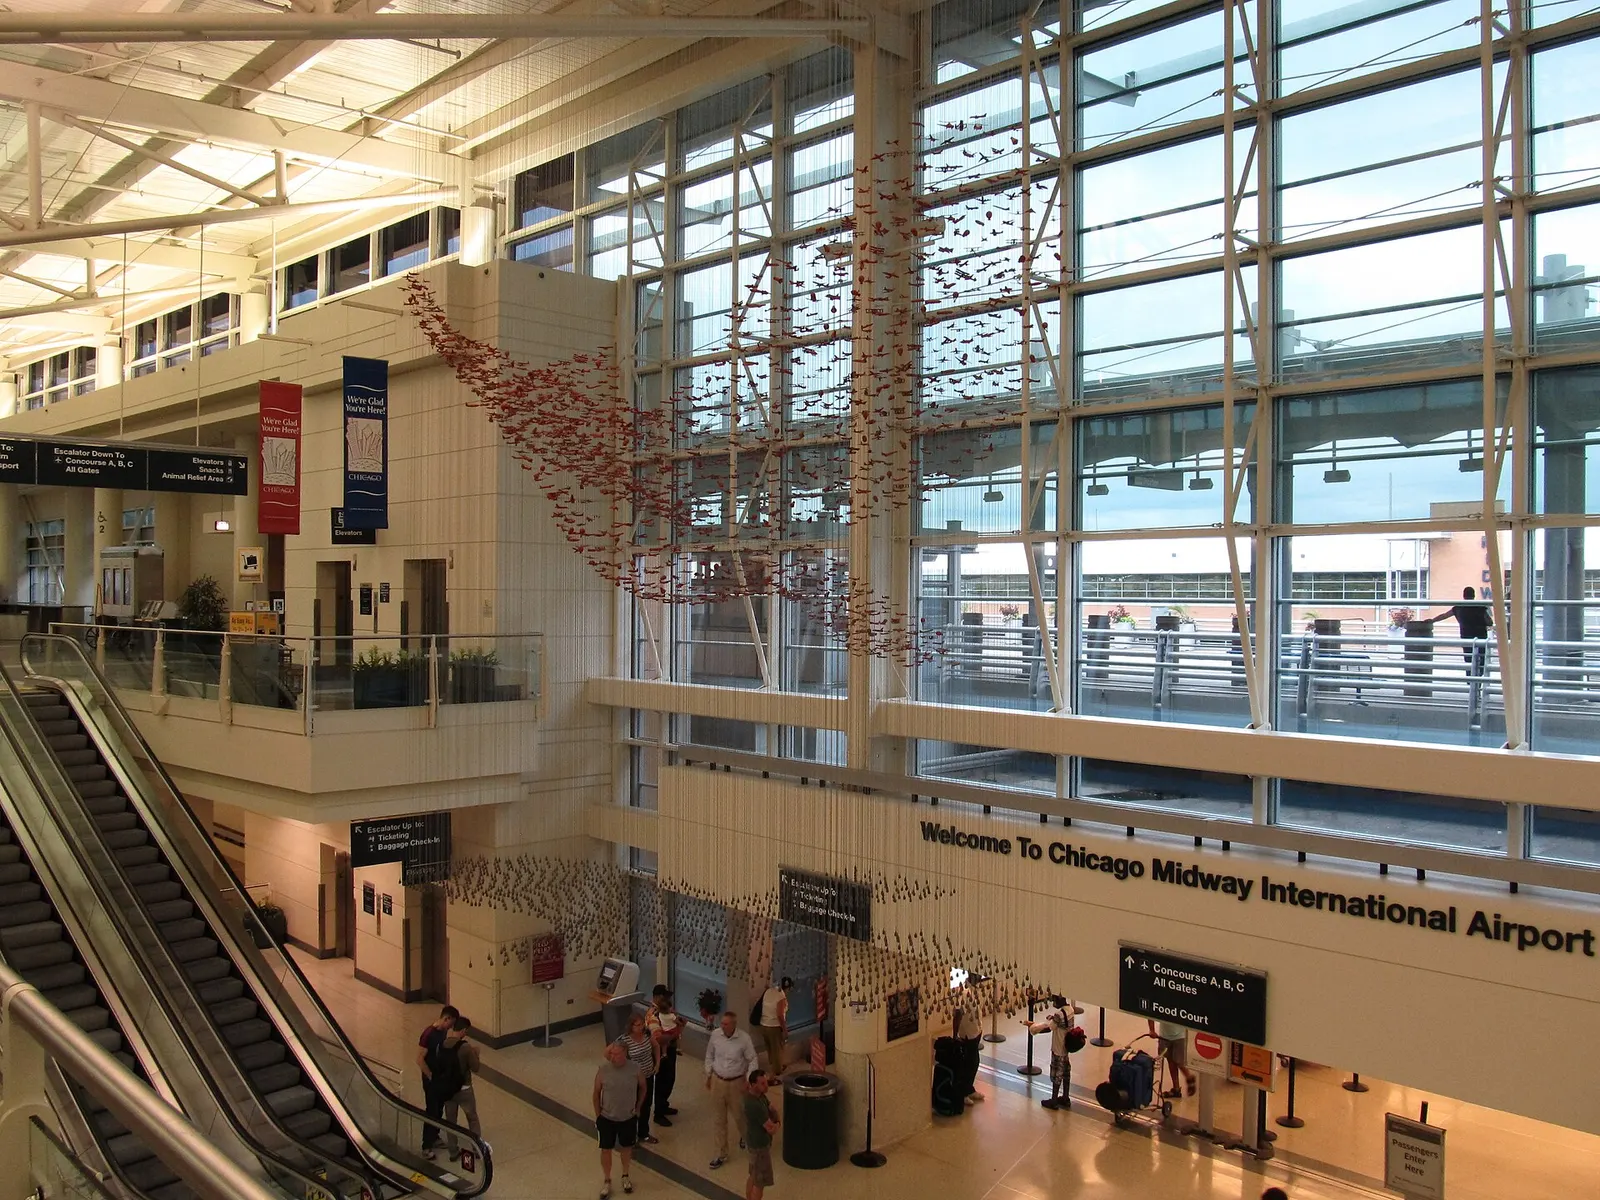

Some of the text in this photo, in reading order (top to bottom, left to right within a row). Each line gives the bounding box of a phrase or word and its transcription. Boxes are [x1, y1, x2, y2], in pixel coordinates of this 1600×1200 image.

[347, 395, 384, 406] We're Glad
[345, 404, 386, 415] You're Here!
[263, 417, 298, 427] We're Glad
[261, 425, 300, 435] You're Here!
[0, 443, 14, 452] To:
[54, 448, 125, 459] Escalator Down To
[65, 457, 134, 468] Concourse A, B, C
[192, 457, 224, 466] Elevators
[78, 466, 100, 474] Gates
[199, 466, 224, 474] Snacks
[162, 472, 186, 480] Animal
[187, 473, 206, 481] Relief
[348, 473, 382, 482] CHICAGO
[263, 486, 295, 494] CHICAGO
[99, 525, 105, 533] 2
[334, 529, 363, 537] Elevators
[367, 824, 400, 834] Escalator
[402, 821, 412, 830] Up
[378, 832, 409, 842] Ticketing
[377, 835, 441, 851] Baggage Check-In
[920, 821, 1596, 957] Welcome To Chicago Midway International Airport
[1153, 963, 1245, 993] Concourse A, B, C
[1153, 976, 1198, 995] All Gates
[1152, 1002, 1209, 1025] Food Court
[1391, 1138, 1439, 1159] Passengers
[1404, 1152, 1427, 1166] Enter
[1404, 1162, 1425, 1176] Here
